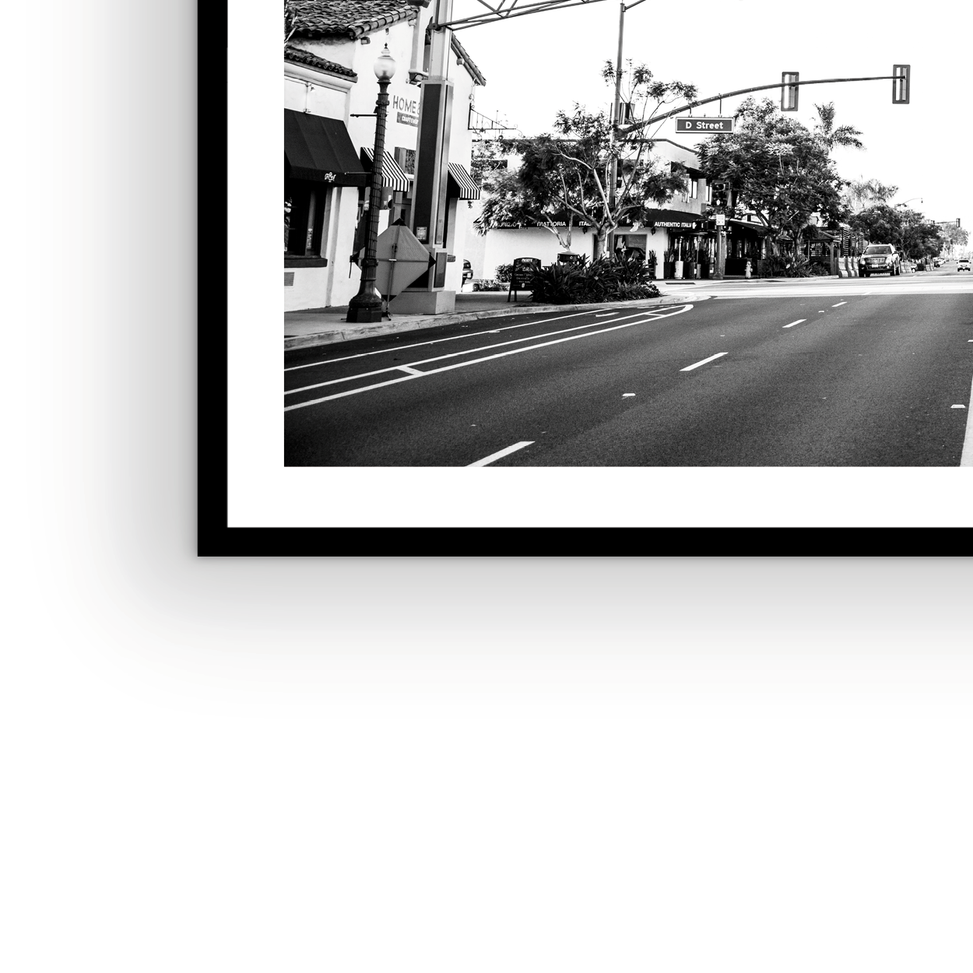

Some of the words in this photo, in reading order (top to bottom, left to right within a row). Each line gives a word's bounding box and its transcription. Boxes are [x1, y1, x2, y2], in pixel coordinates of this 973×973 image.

[393, 95, 417, 114] HOME
[686, 121, 692, 129] D
[696, 121, 724, 129] Street
